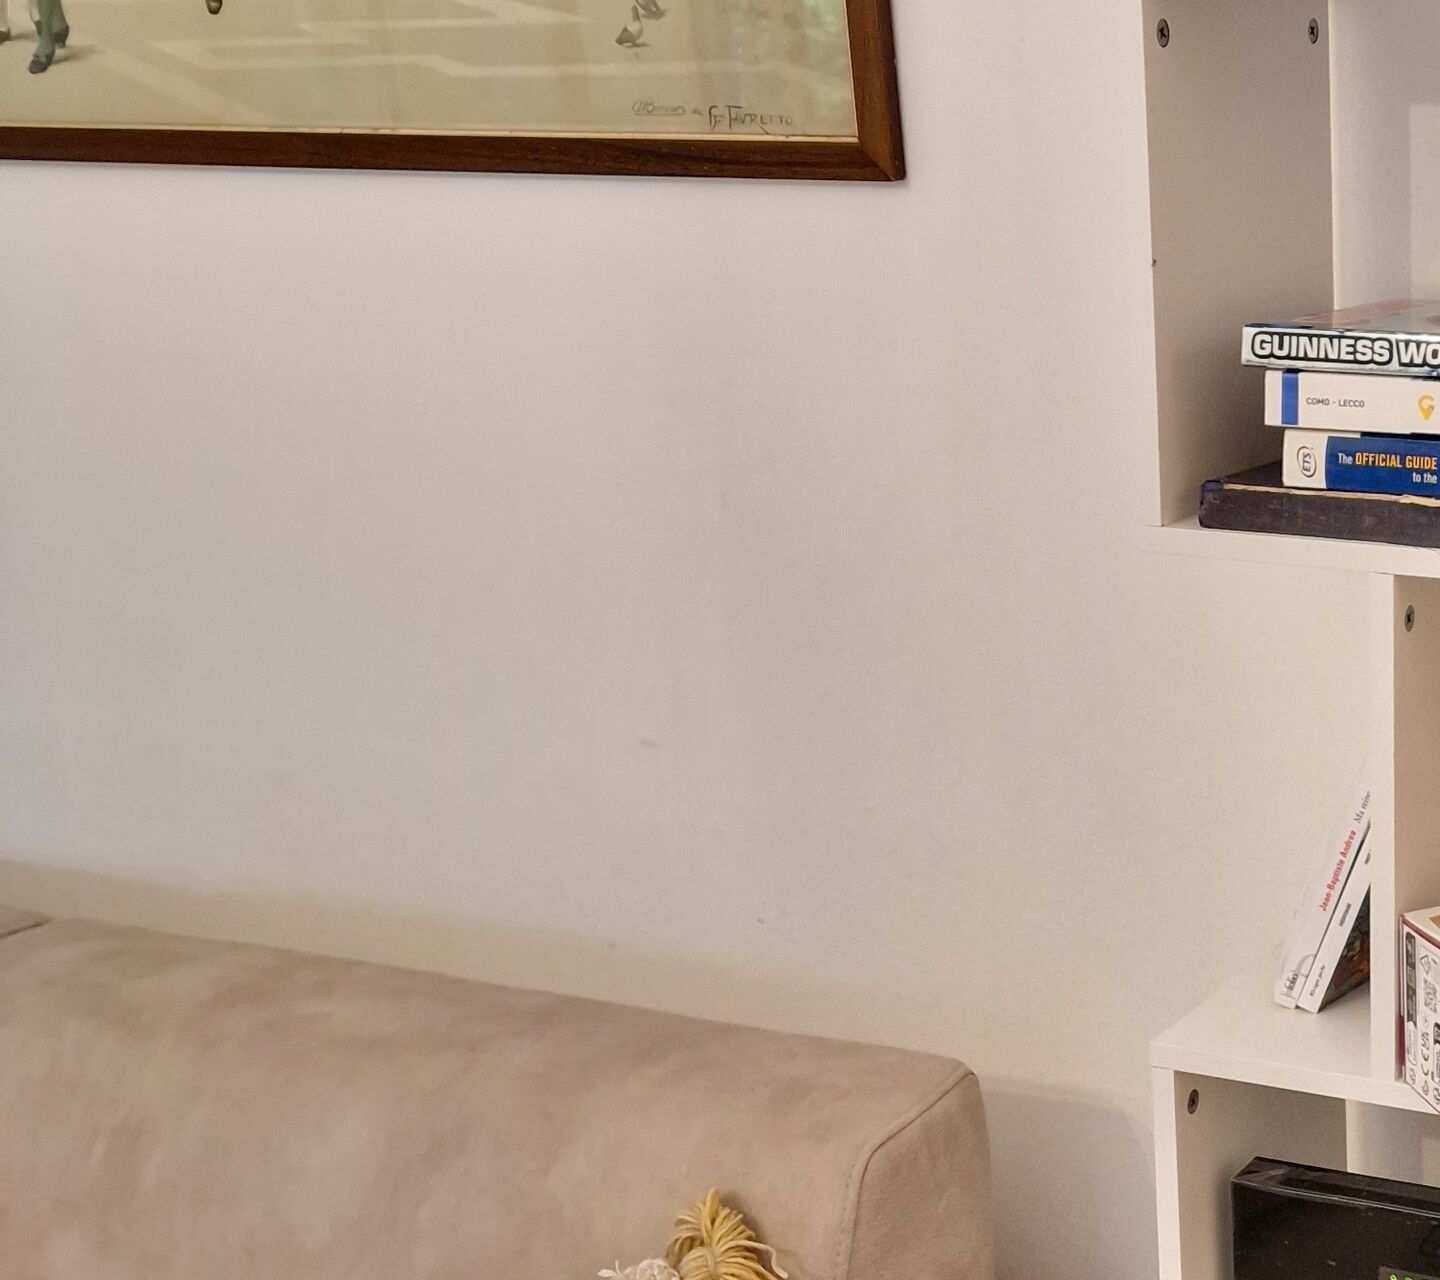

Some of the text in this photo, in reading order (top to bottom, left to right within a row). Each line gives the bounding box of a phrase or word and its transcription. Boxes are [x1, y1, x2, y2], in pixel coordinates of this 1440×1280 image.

[1252, 333, 1391, 363] GUINNESS
[1306, 396, 1365, 409] COMO LECCO
[1302, 452, 1313, 472] ETS
[1337, 452, 1438, 470] The OFFICIAL GUIDE
[1412, 472, 1438, 484] to the
[1318, 829, 1357, 912] Jean-Baptiste Andrea
